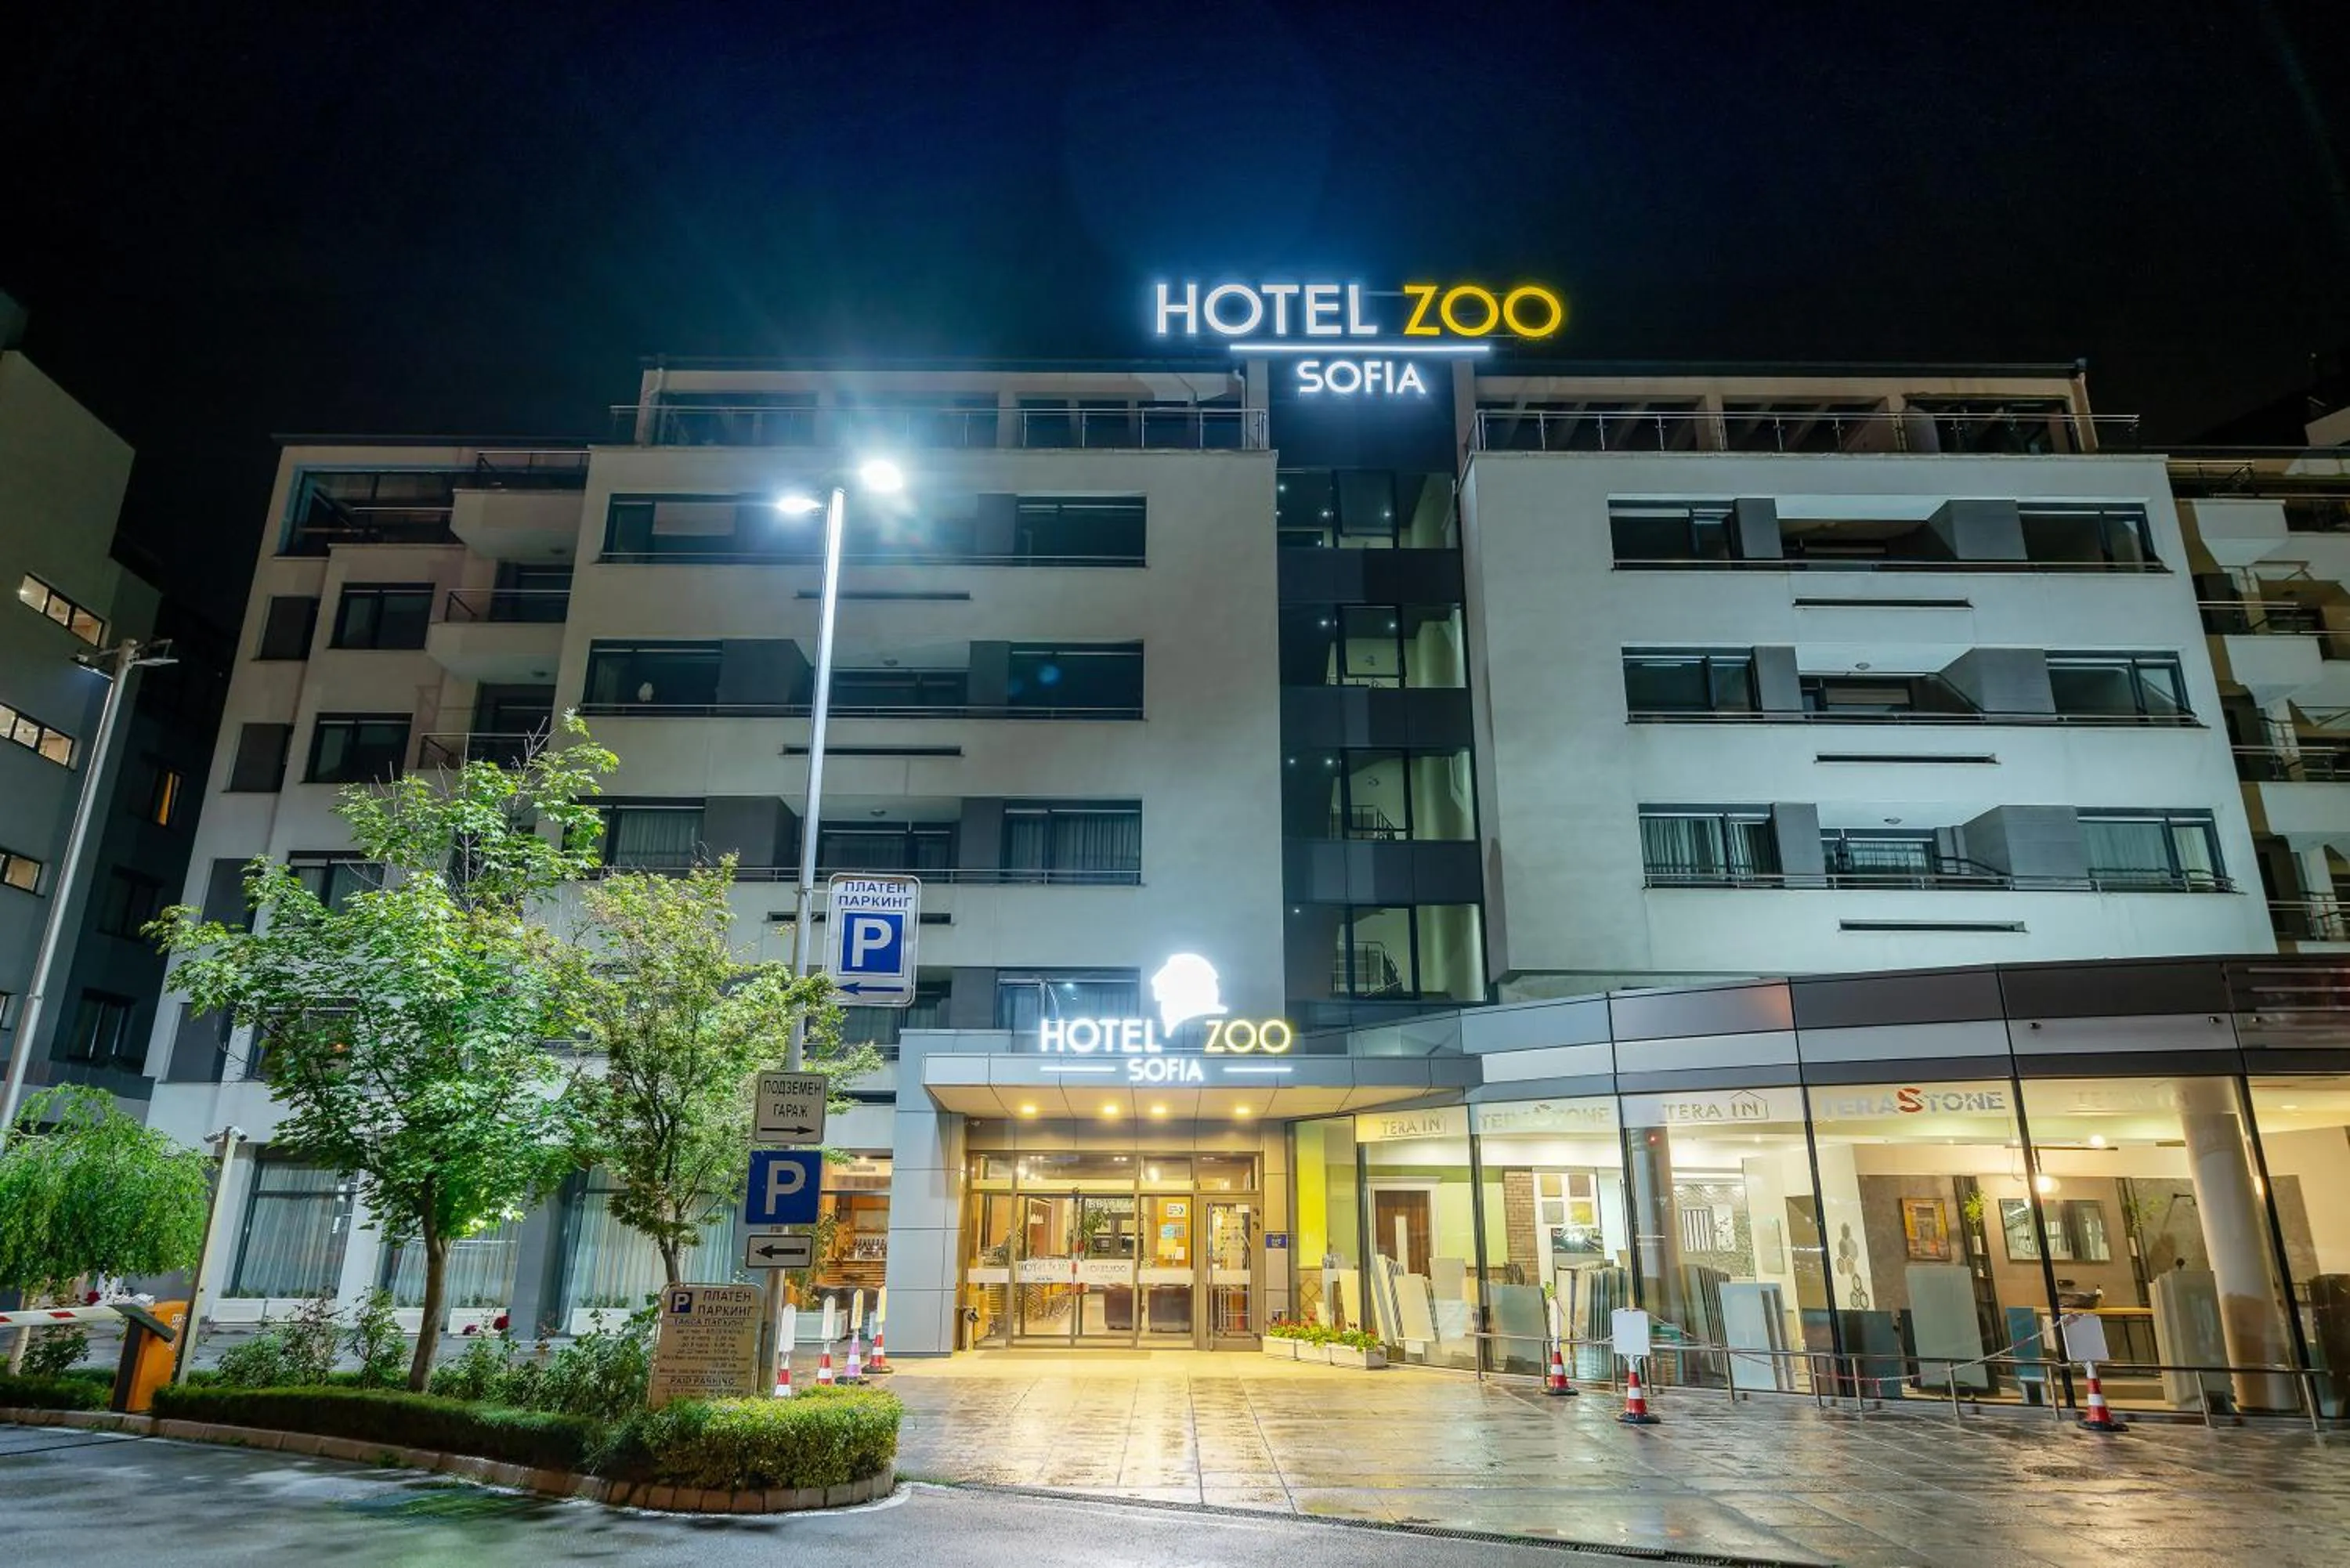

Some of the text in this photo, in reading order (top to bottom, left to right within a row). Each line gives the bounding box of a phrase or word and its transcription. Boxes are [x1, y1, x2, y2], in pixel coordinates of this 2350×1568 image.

[1156, 284, 1562, 337] HOTEL ZOO
[1296, 359, 1426, 394] SOFIA
[844, 881, 907, 894] ПЛАТЕН
[838, 895, 913, 908] ПАРКИНГ
[851, 917, 892, 967] P
[1039, 1018, 1292, 1054] HOTEL ZOO
[1127, 1058, 1205, 1082] SOFIA
[763, 1079, 822, 1096] ПОДЗЕМЕН
[773, 1103, 808, 1118] ГАРАЖ
[1661, 1102, 1723, 1120] TERA
[1380, 1118, 1417, 1134] TERA
[764, 1160, 807, 1215] P
[674, 1293, 690, 1312] P
[703, 1290, 752, 1302] ПЛАТЕН
[698, 1304, 754, 1317] ПАРКИНГ
